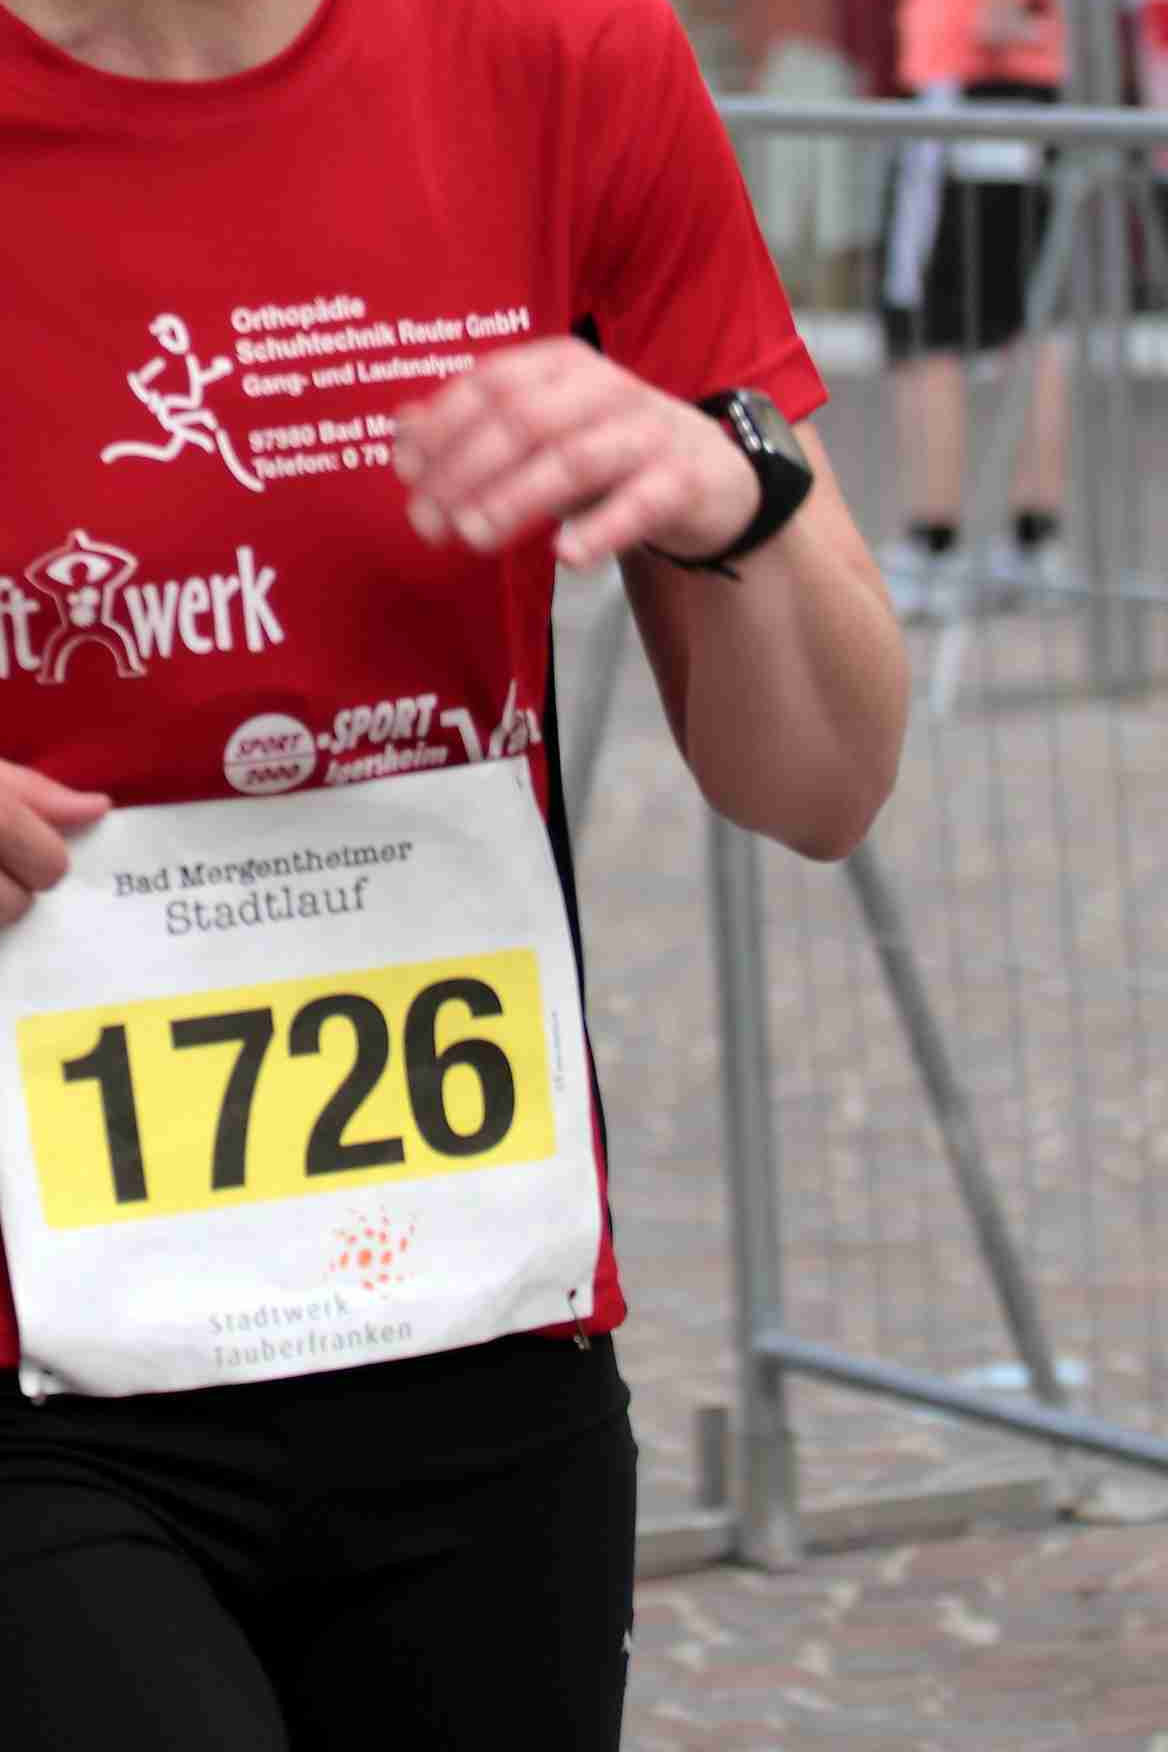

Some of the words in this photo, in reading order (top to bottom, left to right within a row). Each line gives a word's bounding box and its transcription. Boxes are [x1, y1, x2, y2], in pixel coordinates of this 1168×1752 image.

[231, 295, 366, 333] Orthopädie
[235, 322, 396, 365] Schuhtechnik
[465, 306, 530, 339] GmbH
[242, 372, 308, 397] Gang-
[312, 363, 355, 388] und
[318, 416, 363, 444] Bad
[123, 546, 285, 660] werk
[330, 692, 439, 755] SPORT
[113, 868, 169, 897] Bad
[179, 841, 413, 888] Mergentheimer
[164, 875, 370, 936] Stadtlauf
[60, 976, 516, 1205] 1726
[208, 1292, 352, 1334] Stadtwerk
[211, 1319, 414, 1368] Tauberfranken
